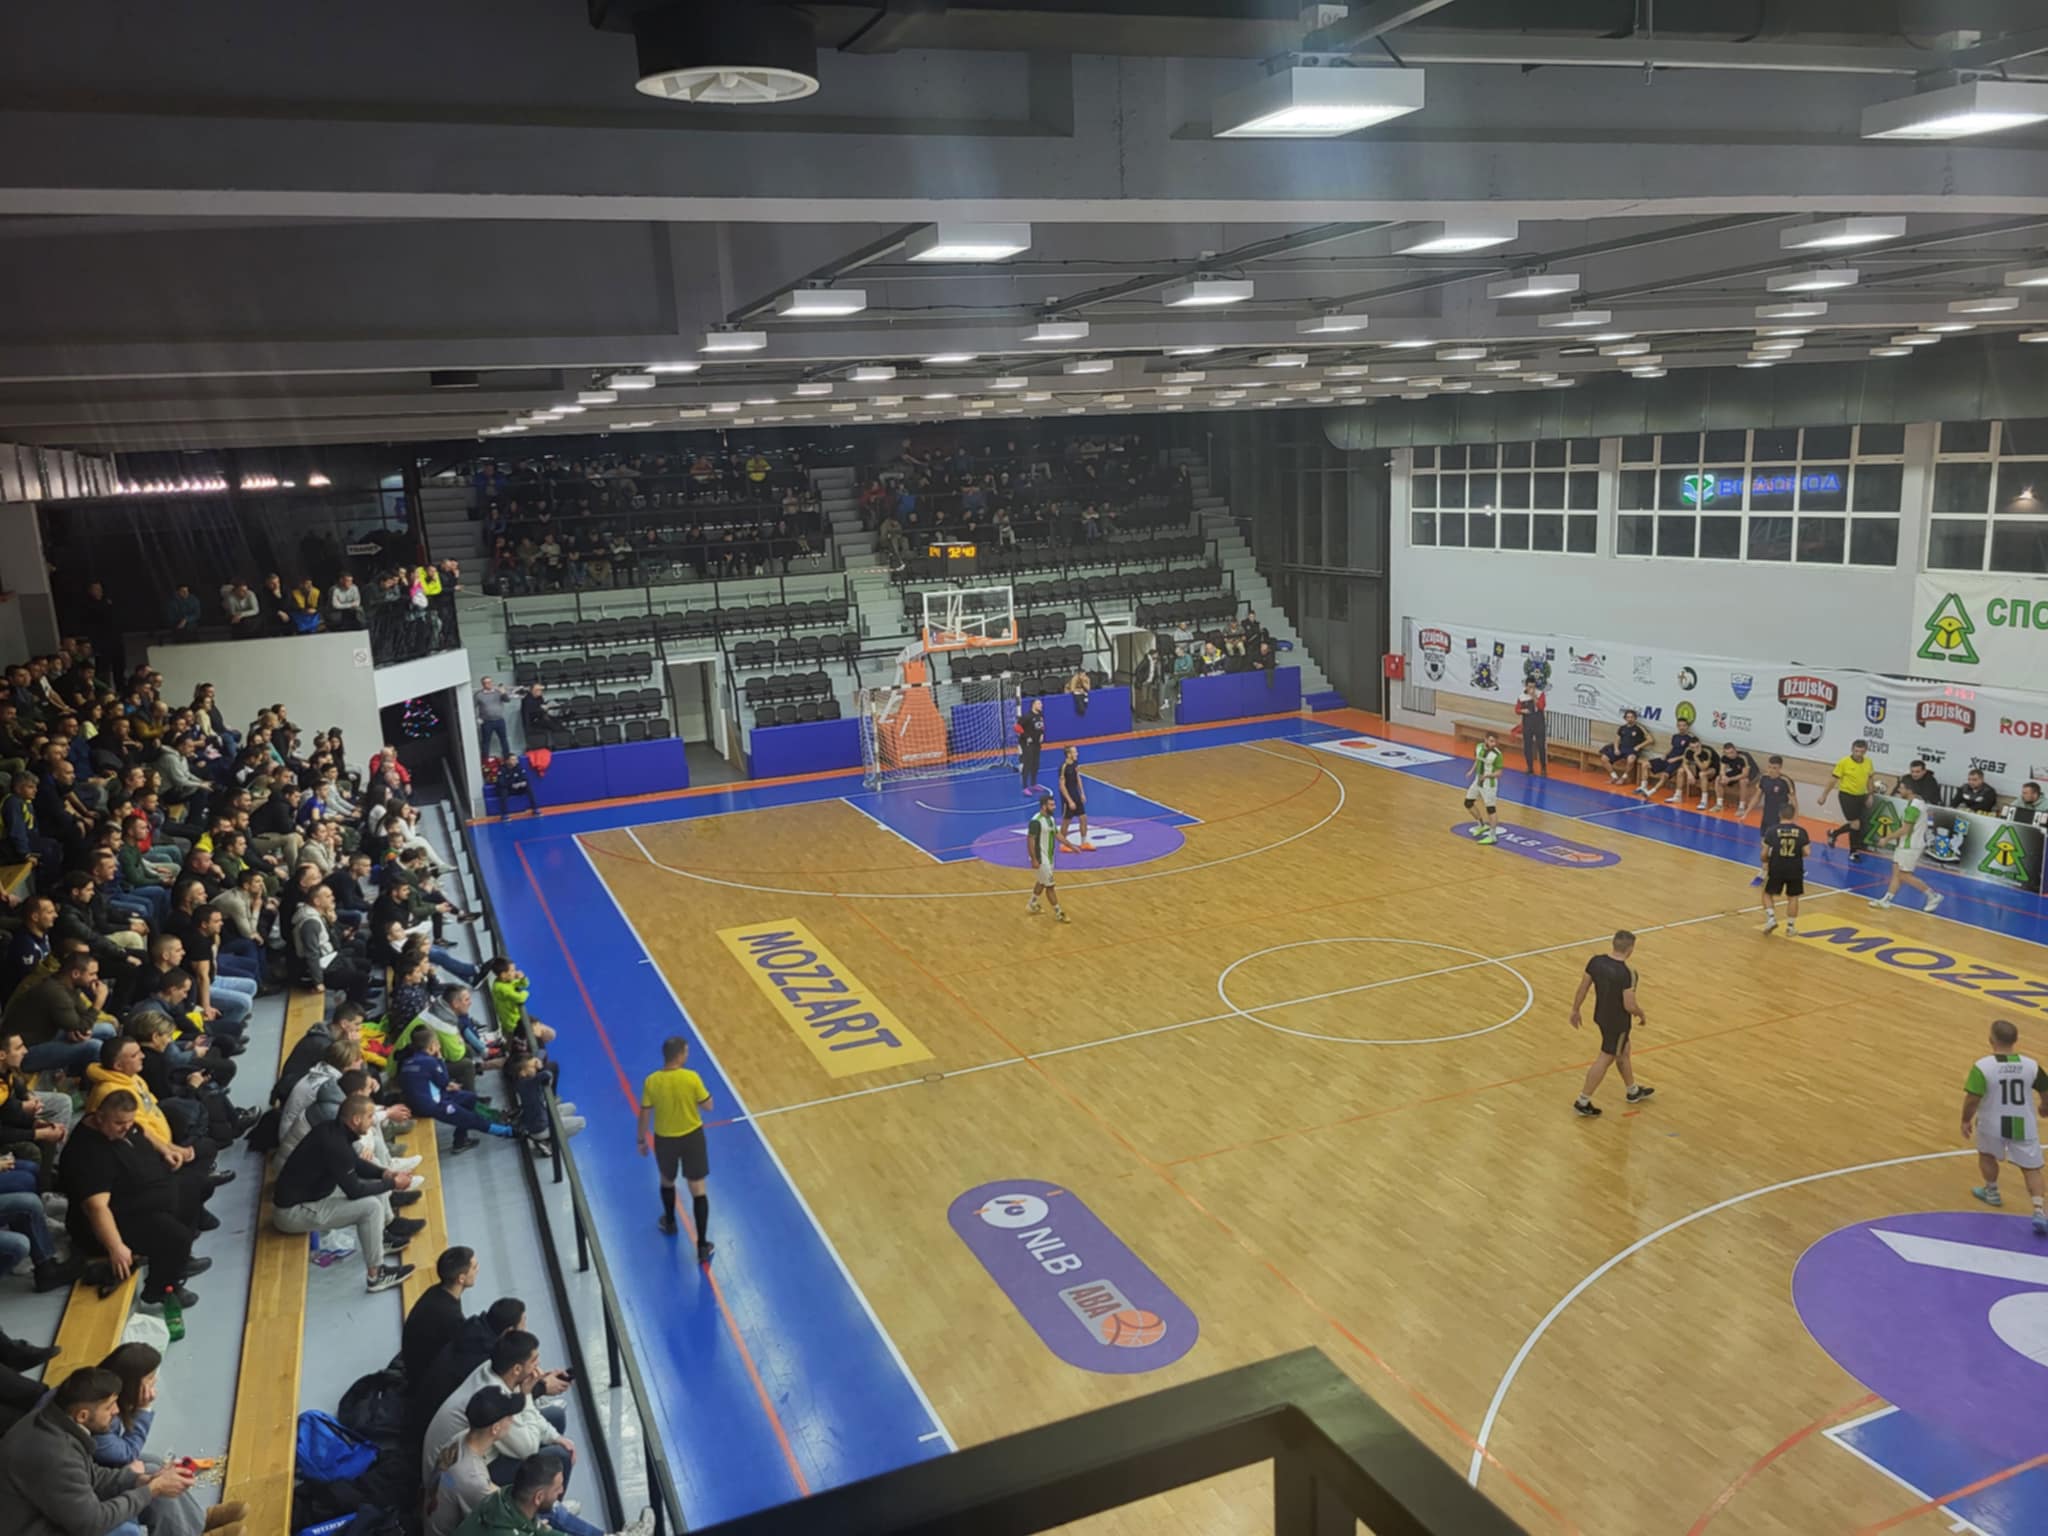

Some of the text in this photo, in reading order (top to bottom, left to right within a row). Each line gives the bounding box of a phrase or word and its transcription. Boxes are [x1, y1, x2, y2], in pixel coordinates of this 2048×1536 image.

[1783, 679, 1833, 701] Ožujsko
[1921, 703, 1970, 724] Ožujsko
[2000, 718, 2048, 740] ROB
[1799, 927, 2048, 1014] MOZZ
[738, 931, 903, 1052] MOZZART
[1999, 1079, 2025, 1106] 10
[1017, 1227, 1082, 1275] NLB
[1068, 1285, 1122, 1319] ABA
